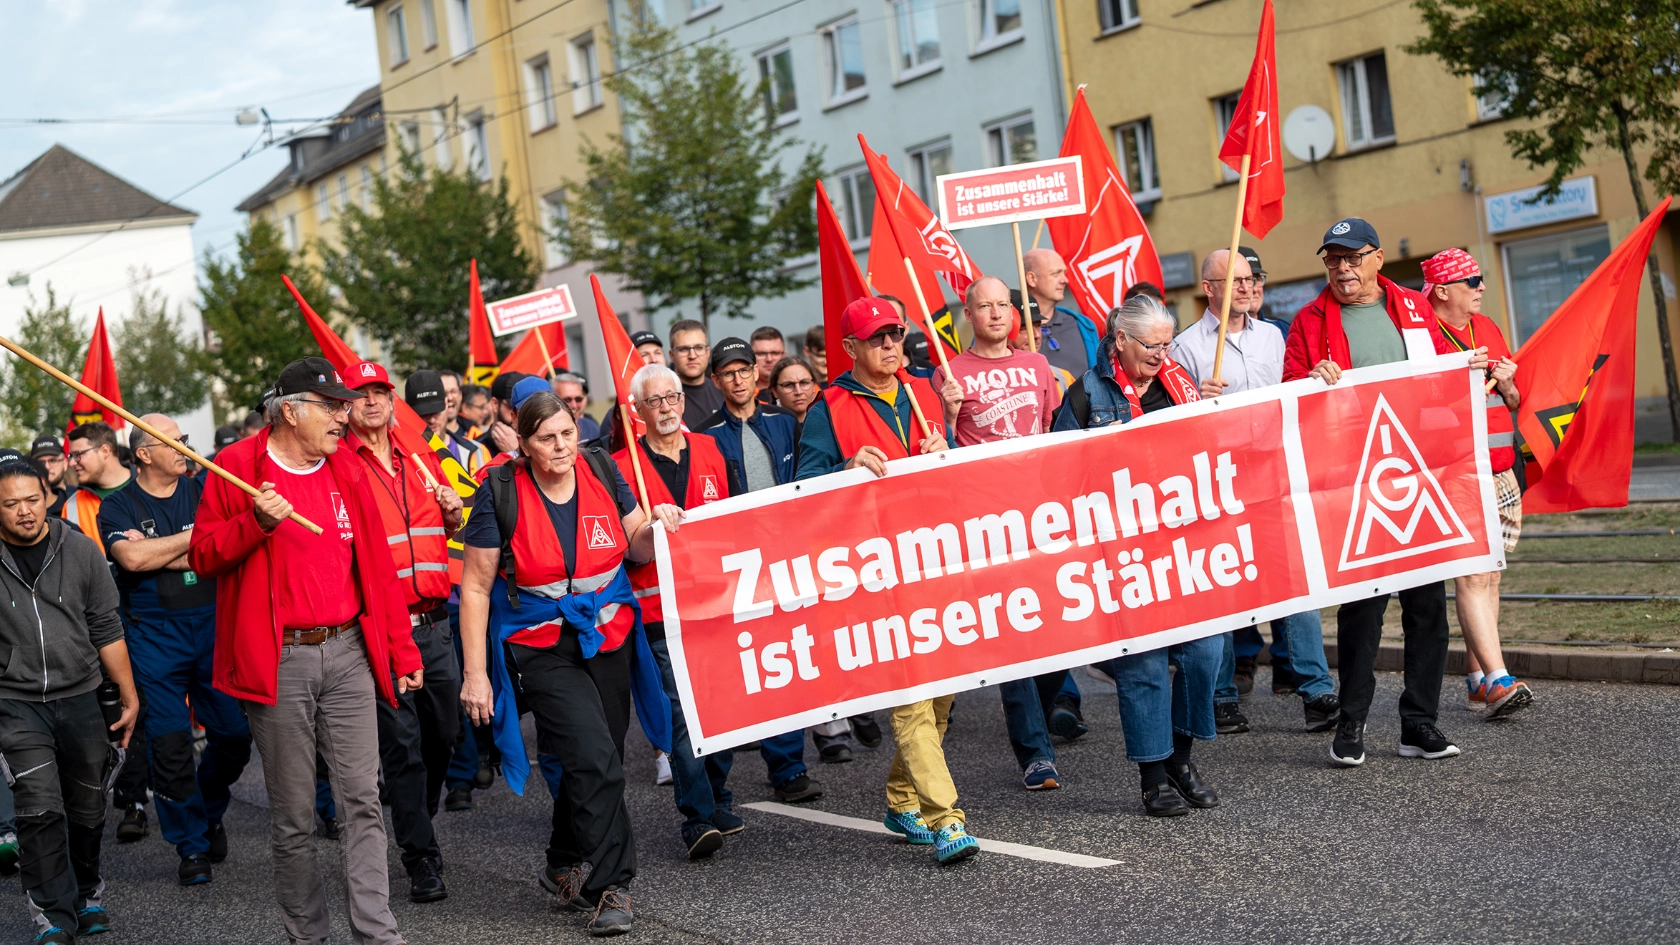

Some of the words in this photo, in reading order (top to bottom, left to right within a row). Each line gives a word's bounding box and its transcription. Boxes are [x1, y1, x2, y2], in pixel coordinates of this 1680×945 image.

[955, 172, 1066, 201] Zusammenhalt
[957, 202, 974, 216] ist
[976, 197, 1020, 213] unsere
[1022, 188, 1069, 207] Stärke!
[723, 343, 746, 352] ALSTOM
[963, 367, 1038, 395] MOIN
[985, 394, 1029, 421] COASTLINE
[0, 454, 19, 463] LSTOM
[721, 451, 1245, 625] Zusammenhalt
[737, 623, 821, 696] ist
[833, 586, 1044, 672] unsere
[1056, 523, 1258, 622] Stärke!
